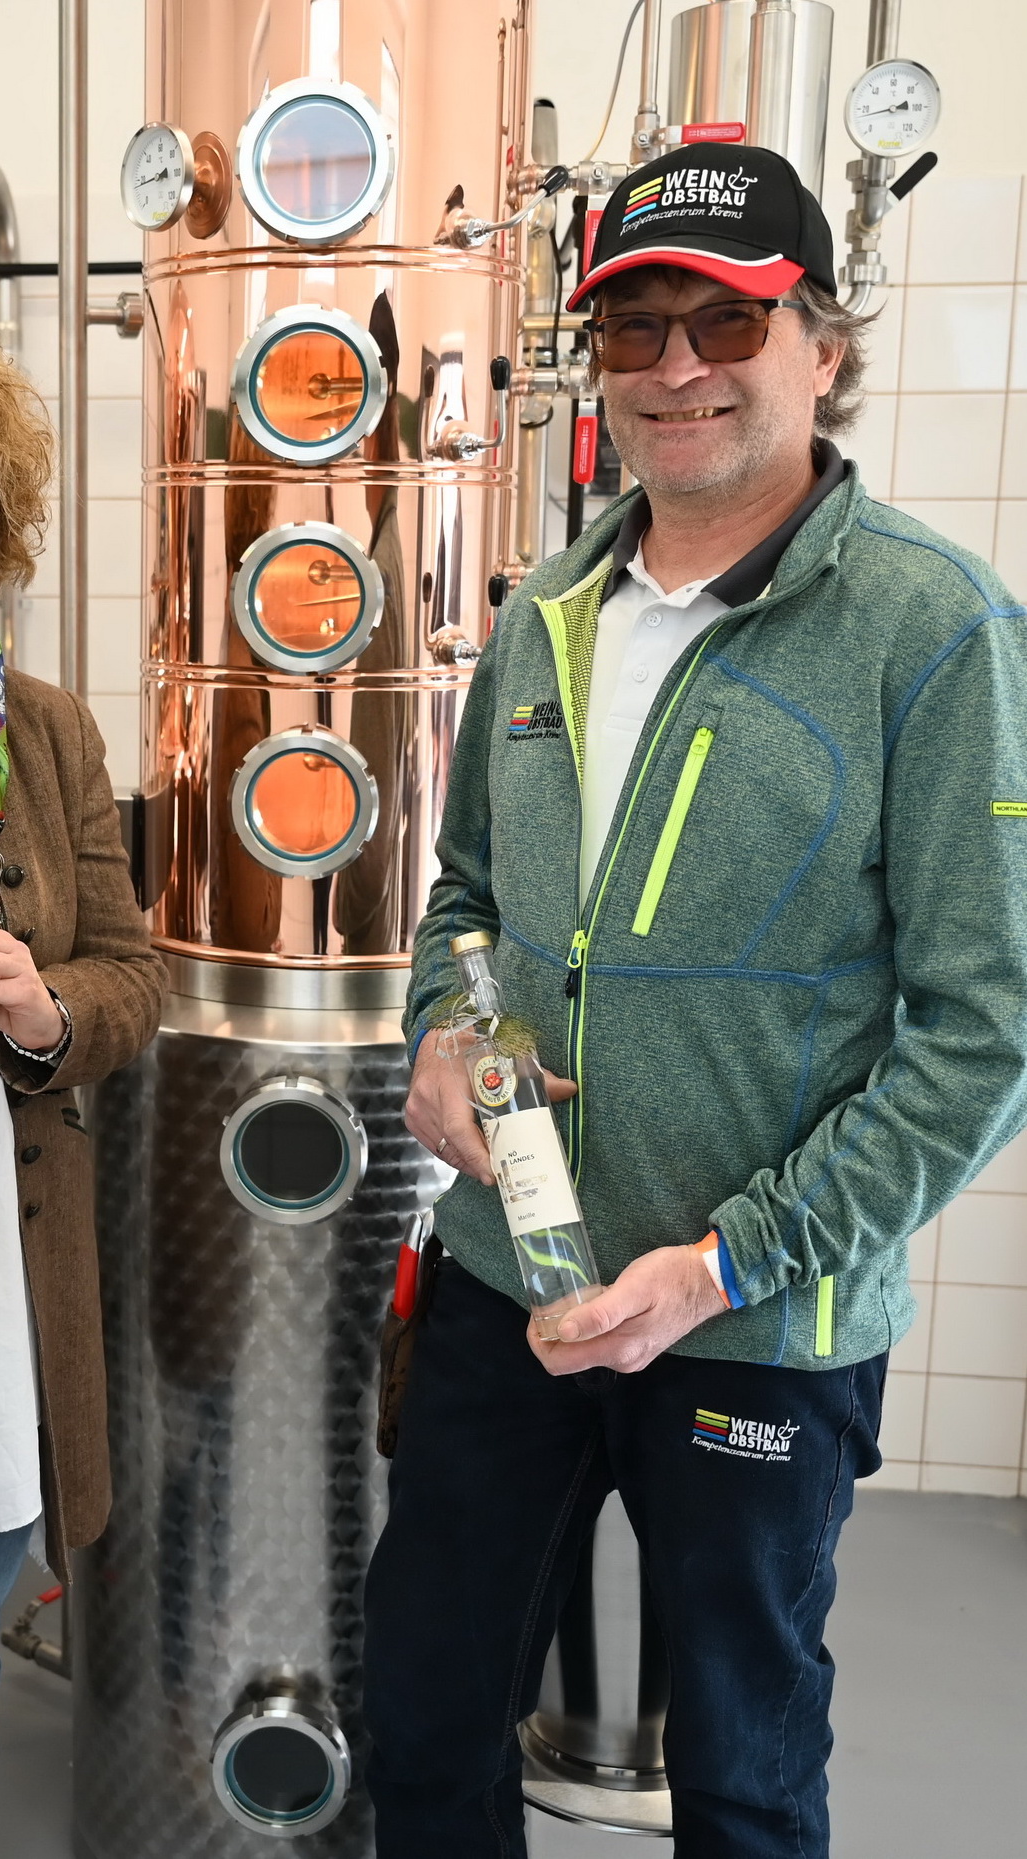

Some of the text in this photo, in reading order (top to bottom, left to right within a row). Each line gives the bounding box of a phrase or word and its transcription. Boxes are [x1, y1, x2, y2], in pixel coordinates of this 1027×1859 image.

[890, 79, 898, 87] 60
[872, 87, 880, 96] 40
[907, 86, 915, 95] 80
[862, 105, 870, 113] 20
[912, 103, 923, 112] 100
[903, 123, 913, 132] 120
[665, 166, 758, 191] WEIN &
[168, 191, 176, 200] 120
[661, 188, 746, 207] OBSTBAU
[707, 205, 744, 219] Krems
[507, 1150, 518, 1159] NÖ
[509, 1154, 535, 1166] LANDES
[517, 1211, 536, 1222] Marille
[731, 1416, 801, 1441] WEIN &
[728, 1432, 791, 1453] OBSTBAU
